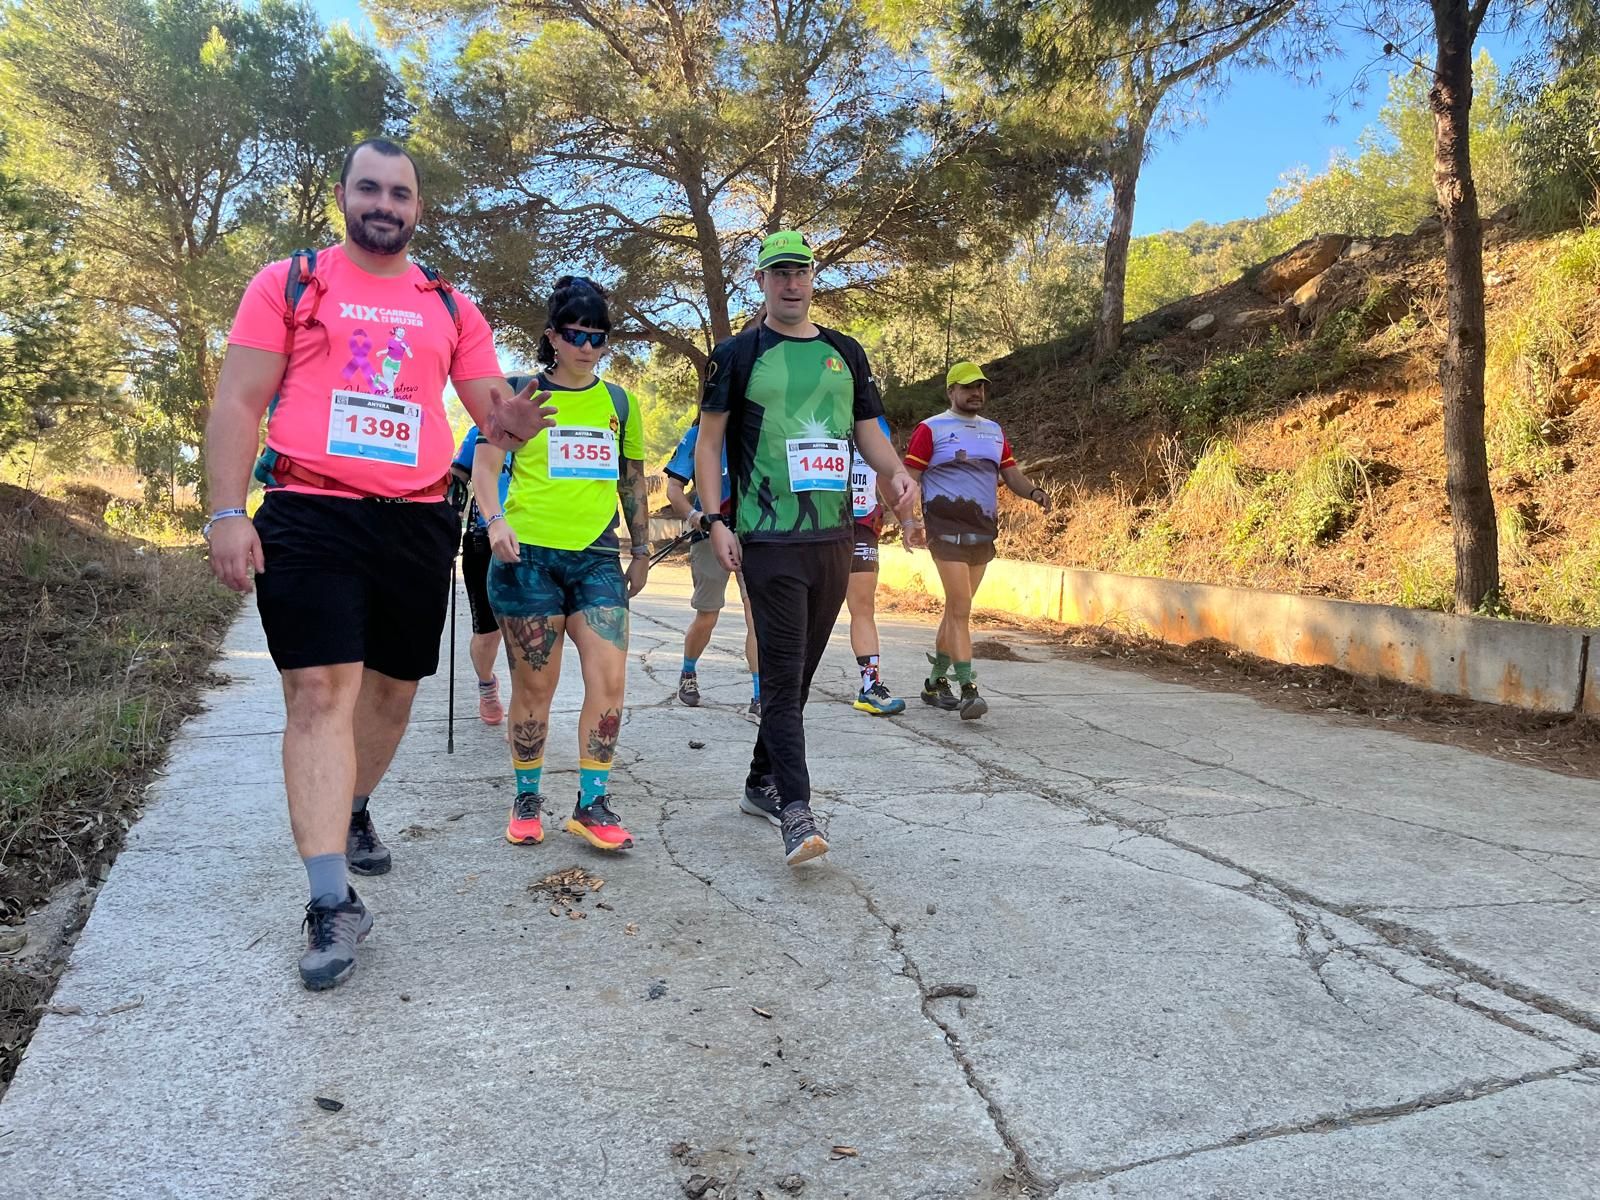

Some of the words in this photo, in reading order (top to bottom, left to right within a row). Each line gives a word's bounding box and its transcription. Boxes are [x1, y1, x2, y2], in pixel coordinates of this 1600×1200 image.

[339, 302, 379, 322] XIX
[379, 308, 423, 320] CARRERA
[390, 317, 424, 327] MUJER
[345, 414, 411, 441] 1398
[560, 443, 611, 461] 1355
[800, 456, 845, 472] 1448
[852, 473, 867, 486] UTA
[854, 496, 867, 505] 42
